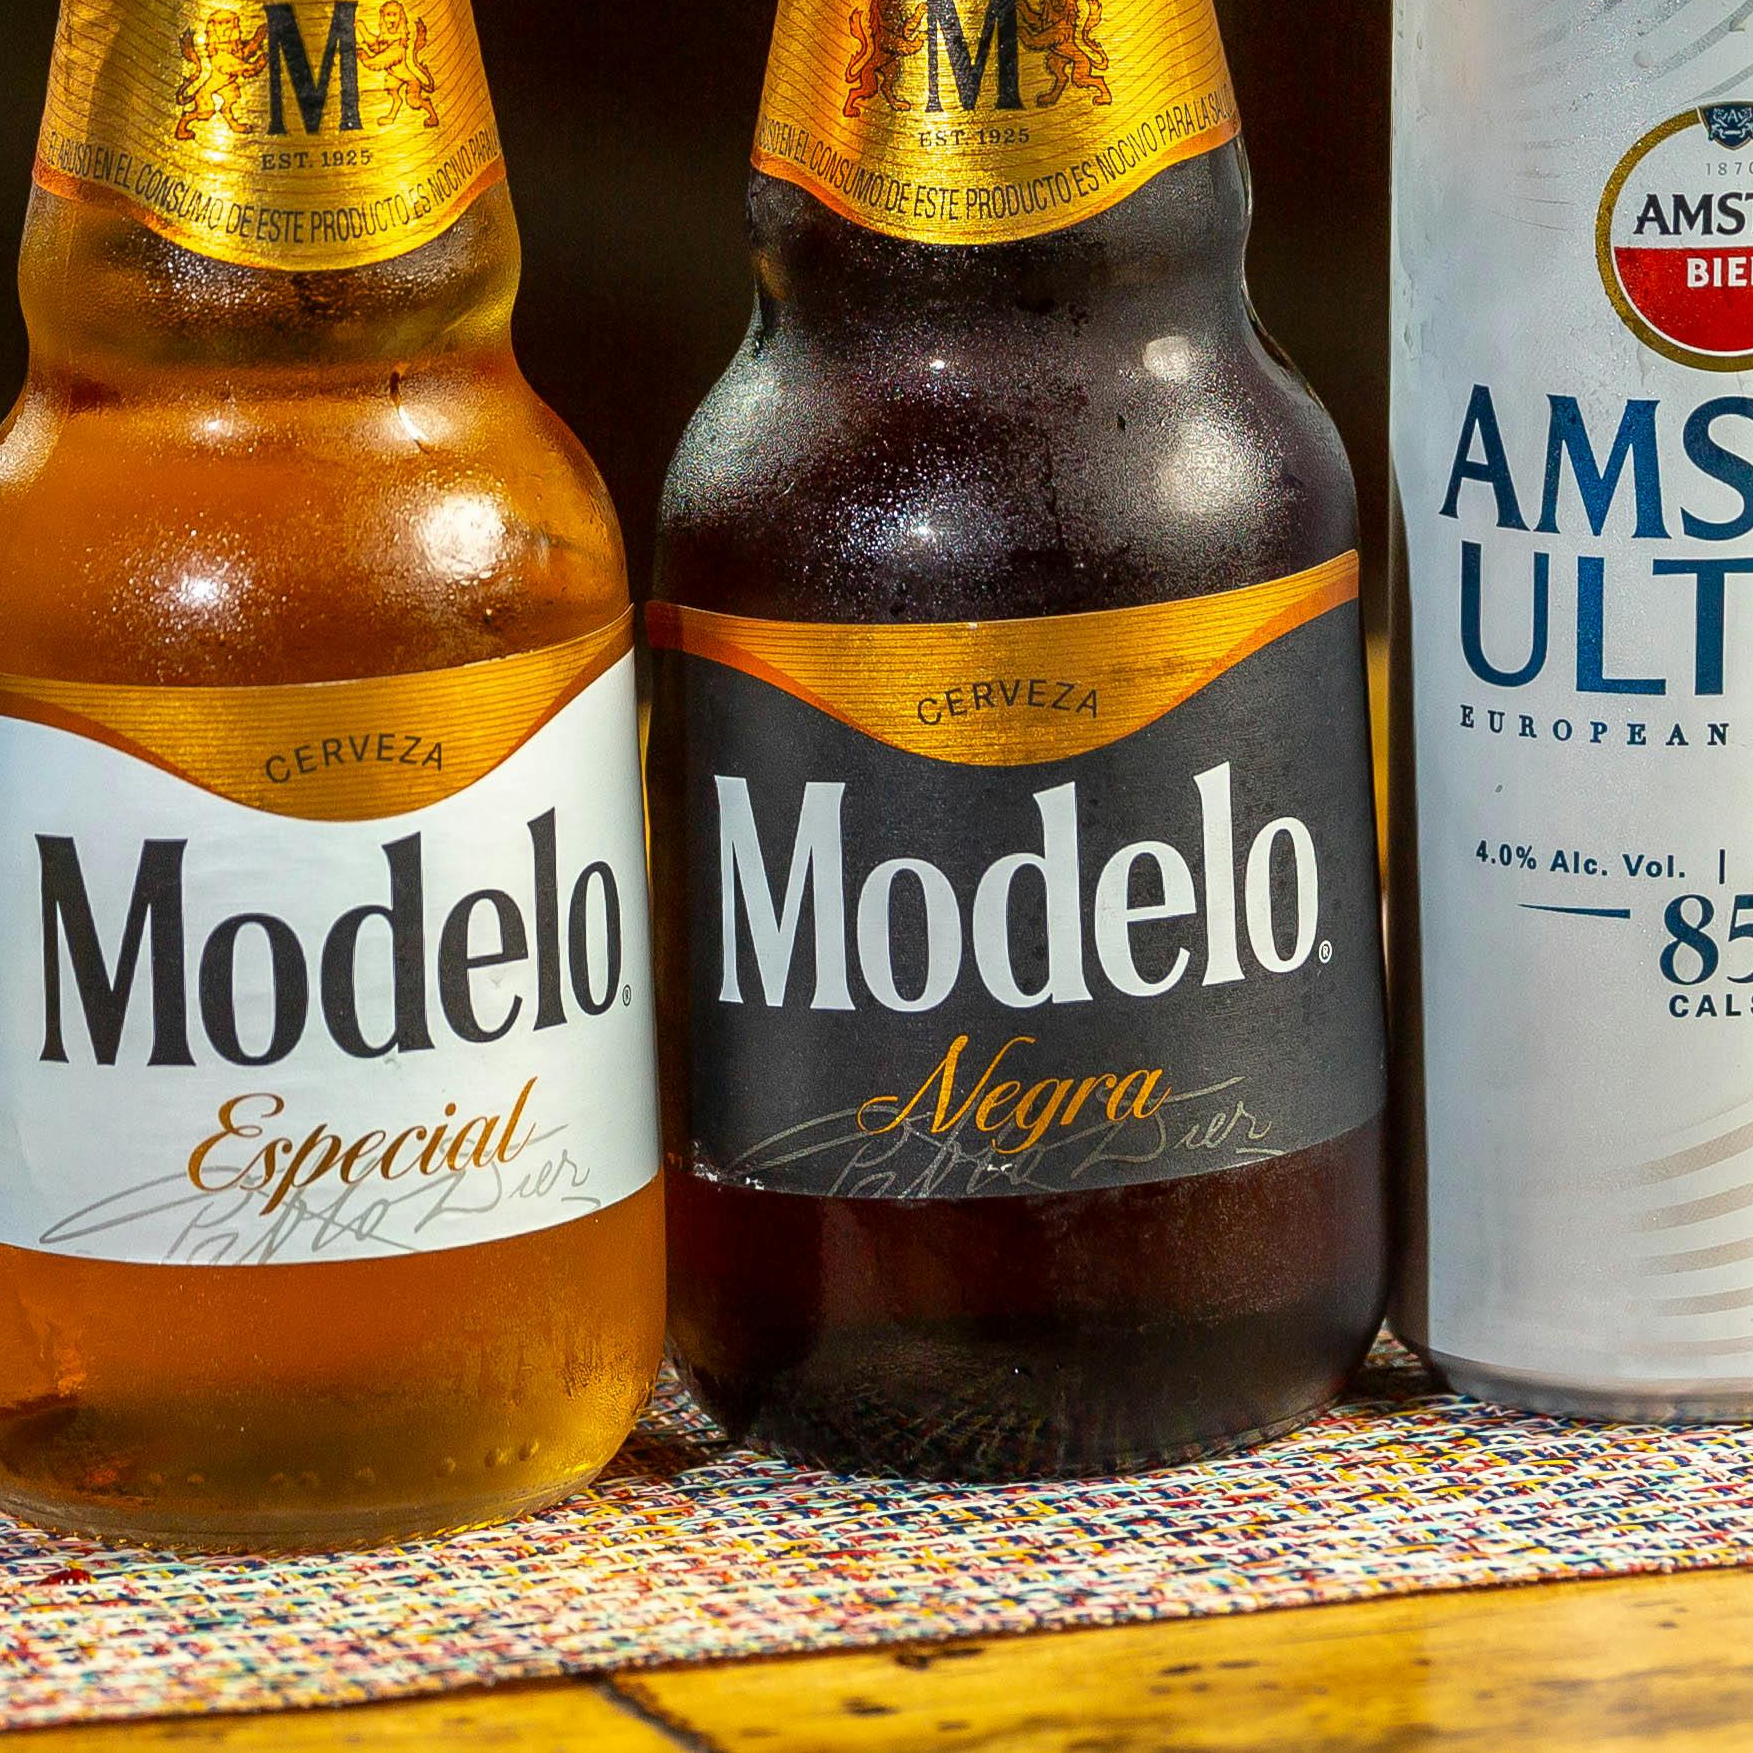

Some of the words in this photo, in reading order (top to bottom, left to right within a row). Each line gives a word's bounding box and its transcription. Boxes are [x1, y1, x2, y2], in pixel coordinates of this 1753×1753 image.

[263, 0, 363, 136] M
[261, 152, 313, 172] EST.
[322, 149, 373, 168] 1925
[809, 140, 885, 208] CONSUMO
[885, 177, 912, 215] DE
[913, 185, 960, 221] ESTE
[966, 171, 1073, 221] PRODUCTO
[1071, 160, 1100, 198] ES
[1096, 121, 1159, 184] NOCIVO
[1154, 103, 1196, 147] PARA
[918, 130, 969, 148] EST.
[978, 127, 1031, 146] 1925
[93, 146, 115, 182] EN
[114, 151, 134, 189] EL
[134, 163, 225, 231] CONSUMO
[225, 201, 255, 238] DE
[256, 207, 305, 244] ESTE
[310, 193, 410, 244] PRODUCTO
[408, 183, 433, 220] ES
[426, 145, 475, 207] NOCIVO
[917, 678, 1101, 726] CERVEZA
[1460, 703, 1731, 747] EUROPEAN
[265, 732, 445, 785] CERVEZA
[713, 760, 1319, 1014] Modelo
[1475, 839, 1538, 871] 4.0%
[1550, 849, 1608, 877] Alc.
[1622, 854, 1686, 879] Vol.
[34, 805, 624, 1067] Modelo
[857, 1034, 1172, 1155] Negra
[186, 1075, 538, 1216] Especial
